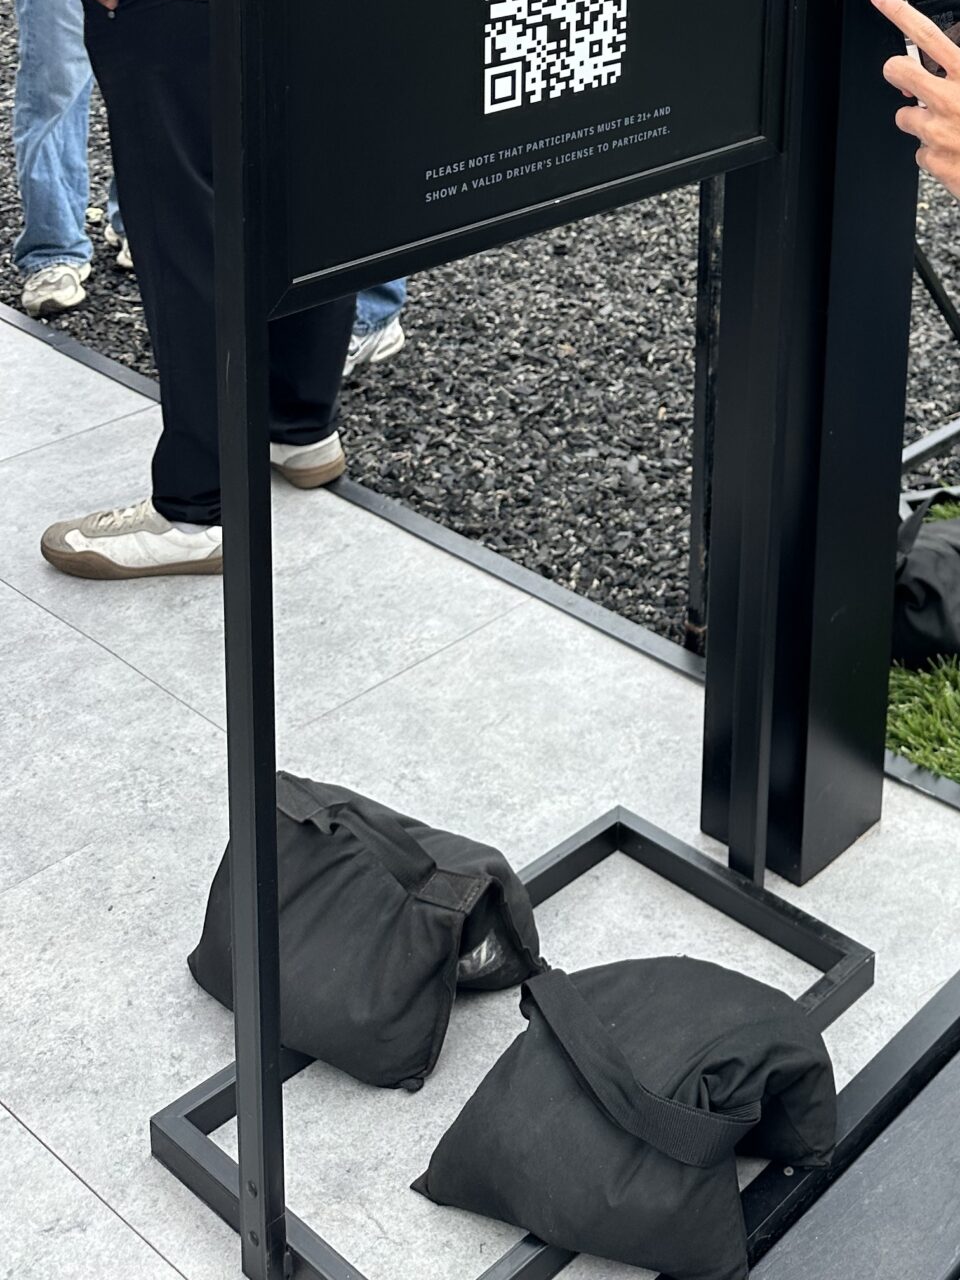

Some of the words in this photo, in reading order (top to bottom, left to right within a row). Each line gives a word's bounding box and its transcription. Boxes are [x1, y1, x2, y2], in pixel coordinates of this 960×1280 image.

[425, 160, 465, 181] PLEASE
[468, 152, 496, 169] NOTE
[498, 145, 524, 161] THAT
[526, 126, 595, 153] PARTICIPANTS
[597, 118, 622, 134] MUST
[624, 115, 635, 127] BE
[637, 111, 652, 123] 21+
[653, 105, 671, 119] AND
[425, 184, 458, 203] SHOW
[460, 182, 469, 193] A
[471, 172, 503, 190] VALID
[506, 158, 552, 180] DRIVER'S
[555, 146, 594, 166] LICENSE
[597, 142, 609, 154] TO
[612, 125, 671, 149] PARTICIPATE.
